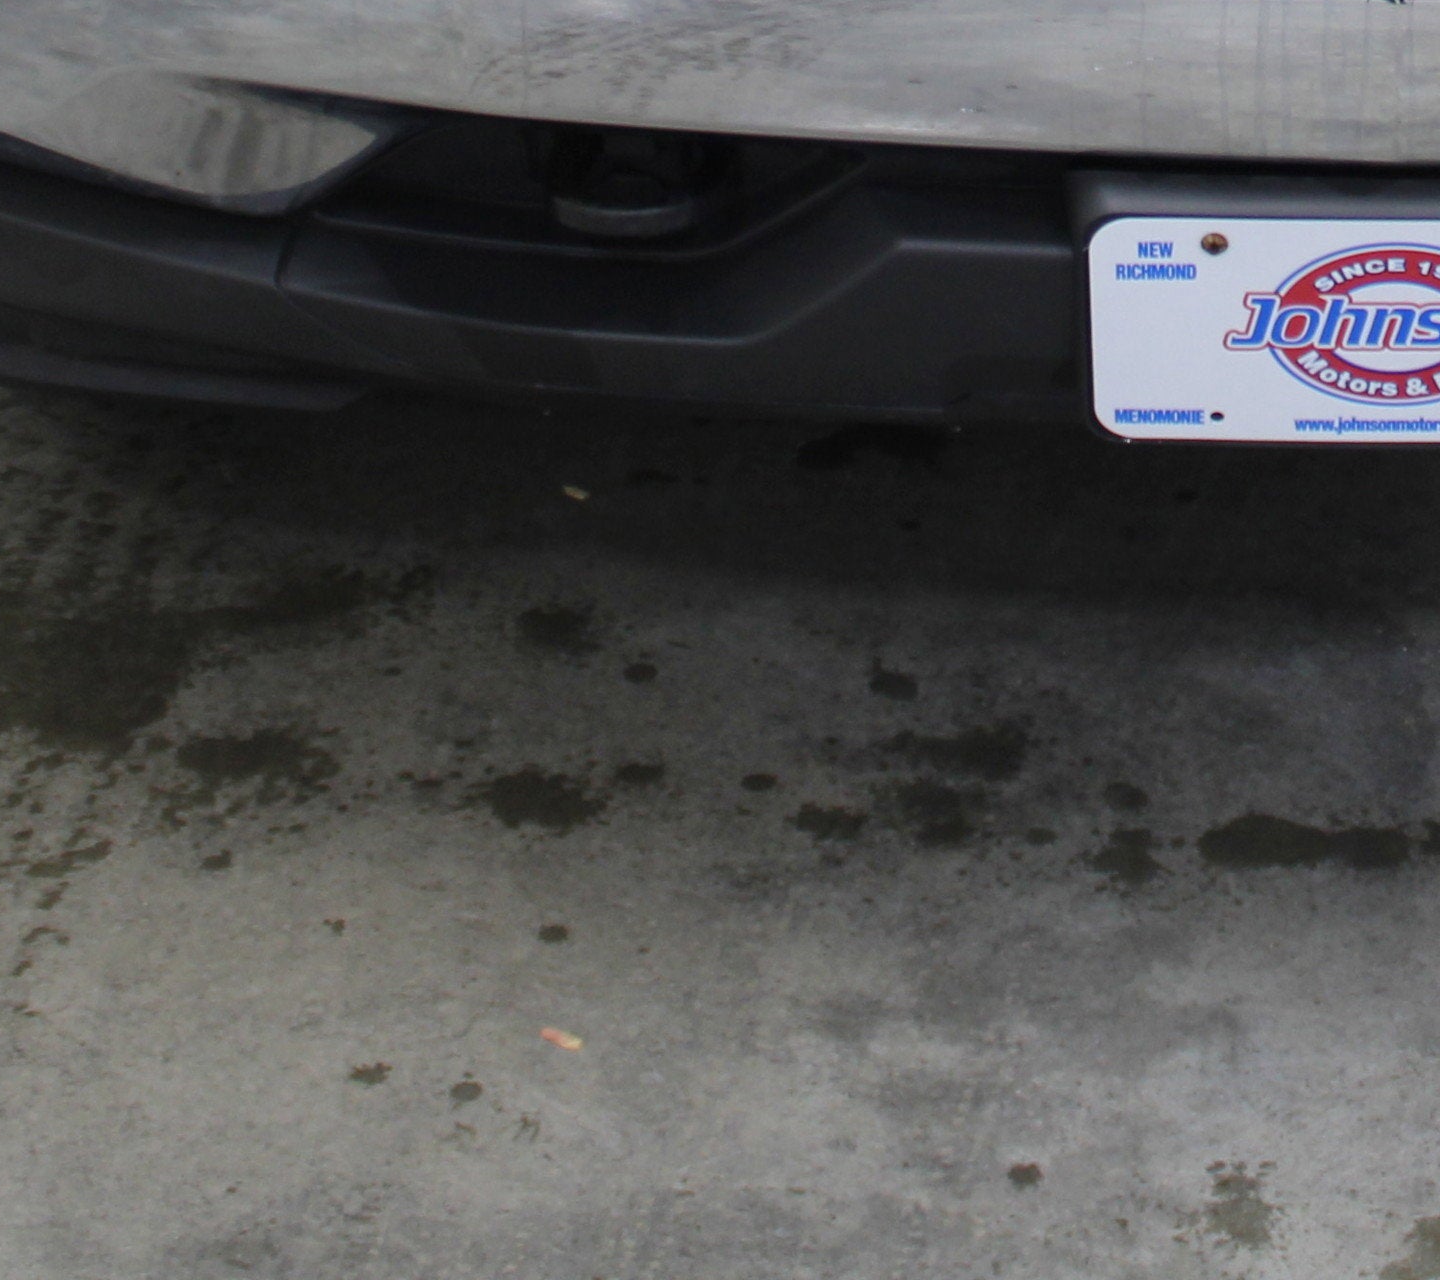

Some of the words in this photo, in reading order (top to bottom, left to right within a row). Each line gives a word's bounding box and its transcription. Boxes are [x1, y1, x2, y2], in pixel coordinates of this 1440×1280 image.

[1137, 241, 1174, 258] NEW
[1115, 263, 1197, 281] RICHMOND
[1313, 257, 1406, 292] SINCE
[1296, 349, 1399, 397] Motors
[1405, 376, 1431, 397] &
[1114, 408, 1205, 425] MENOMONIE
